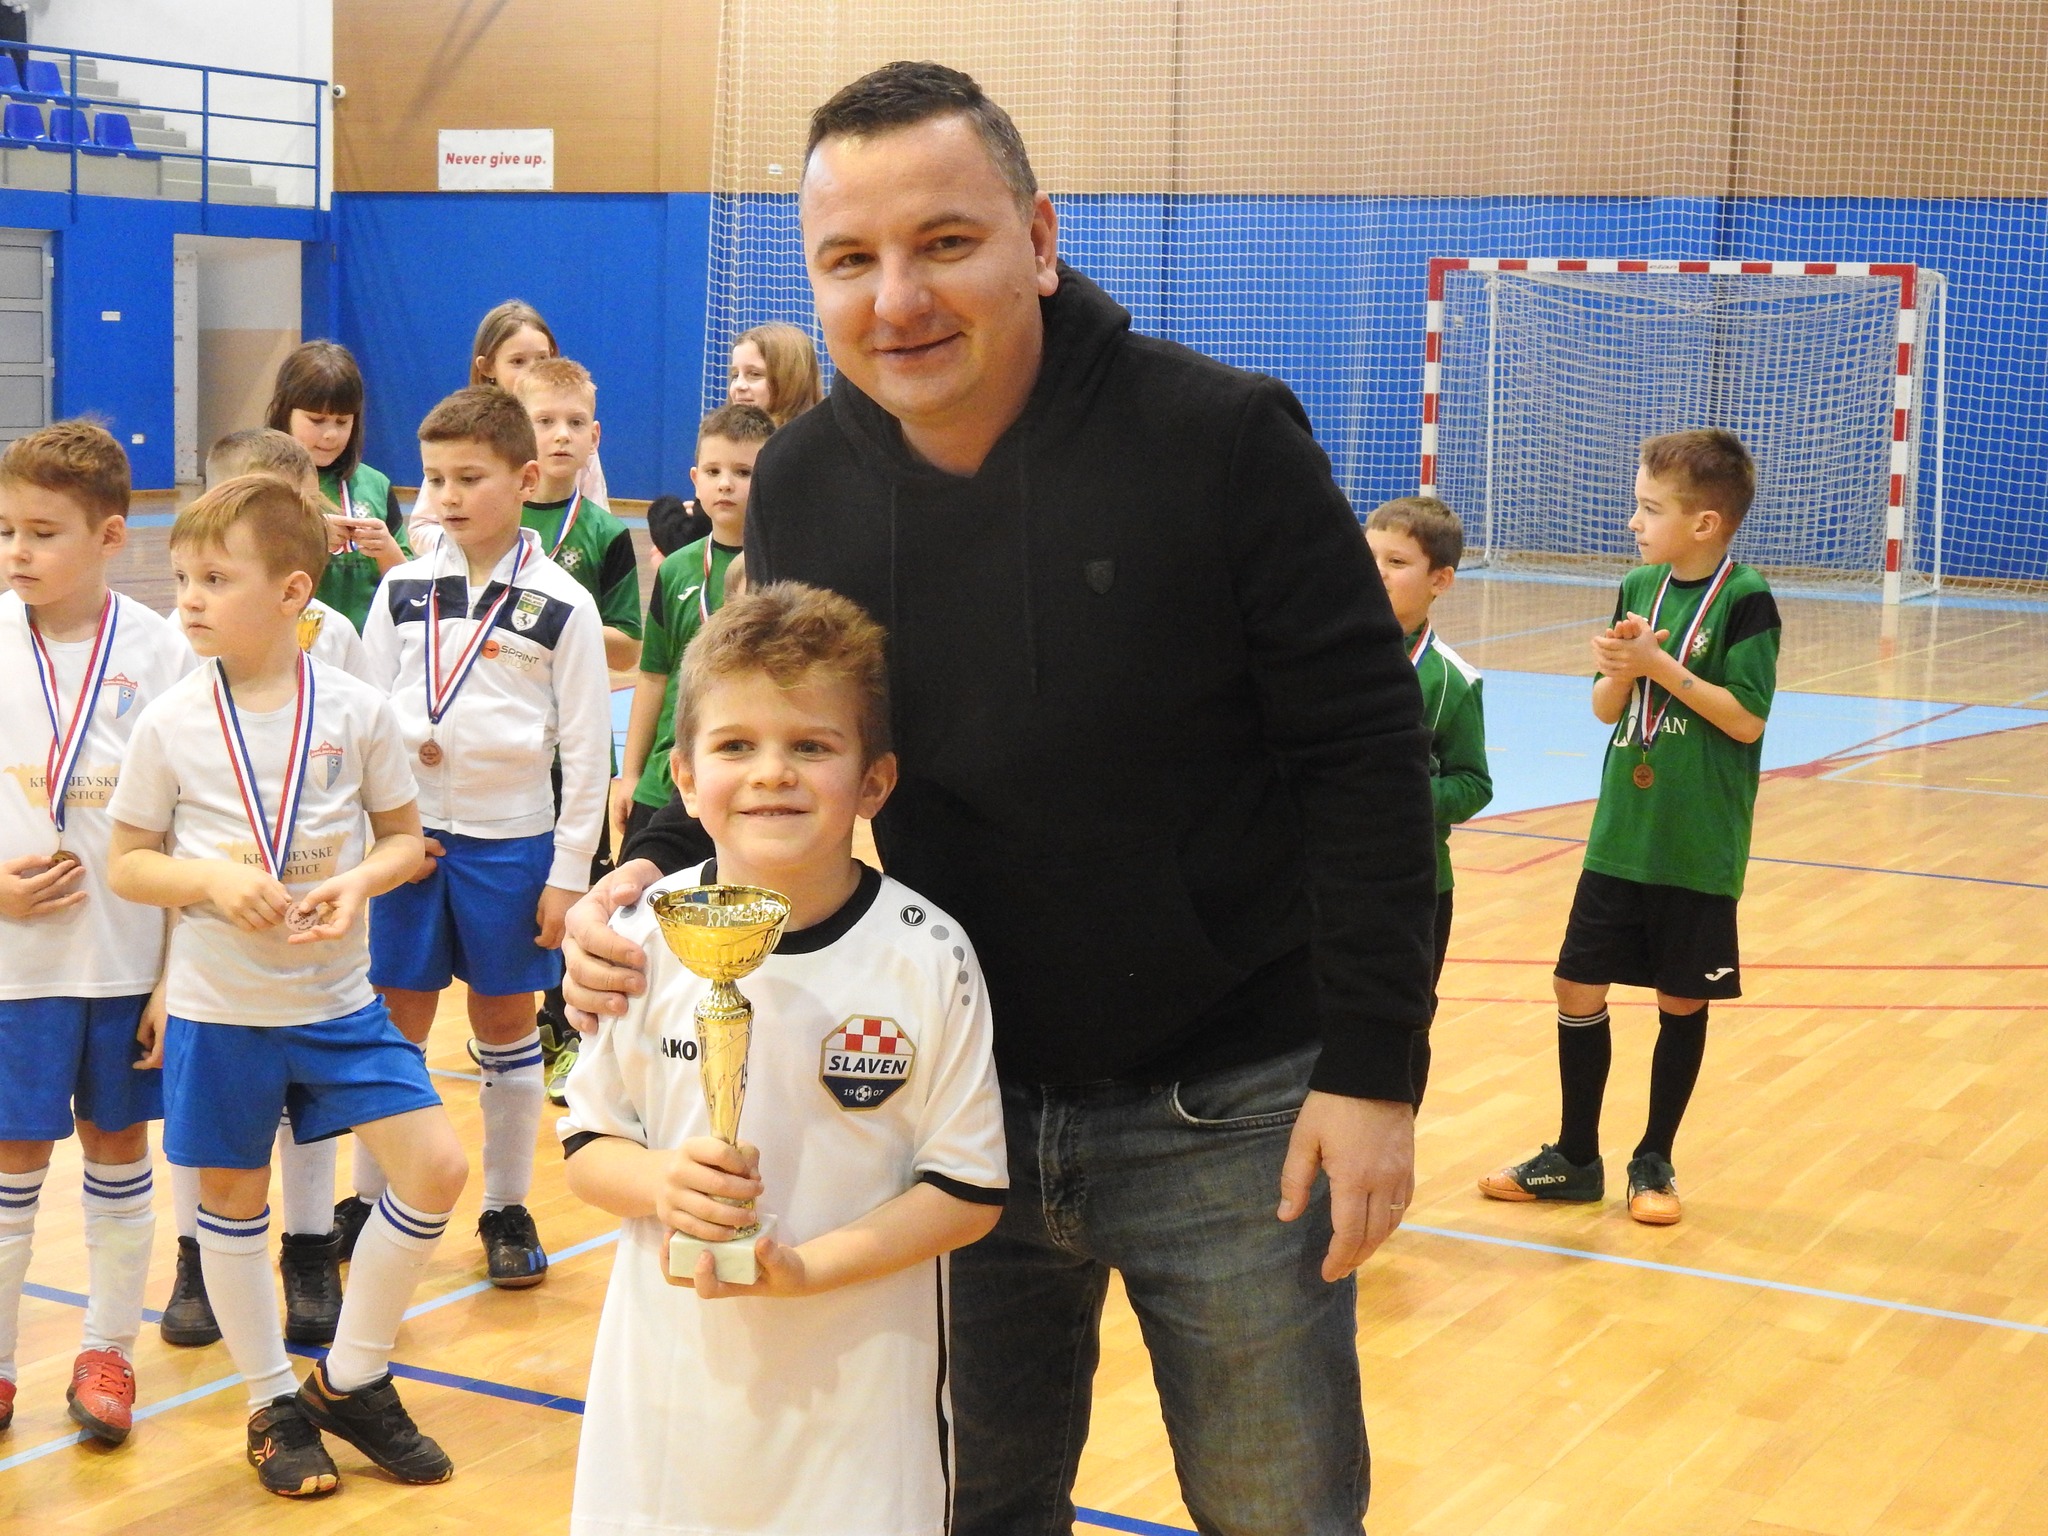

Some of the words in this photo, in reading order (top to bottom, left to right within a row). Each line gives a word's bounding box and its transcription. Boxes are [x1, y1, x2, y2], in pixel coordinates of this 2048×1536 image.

[445, 152, 487, 165] Never
[490, 151, 521, 168] give
[524, 154, 547, 168] up.
[500, 645, 540, 664] SPRINT
[1657, 715, 1689, 735] AN
[29, 776, 120, 788] KRJEVSKE
[243, 846, 334, 865] KRJEVSKE
[660, 1036, 698, 1061] AKO
[828, 1055, 907, 1075] SLAVEN
[843, 1088, 855, 1097] 19
[872, 1089, 884, 1097] 07
